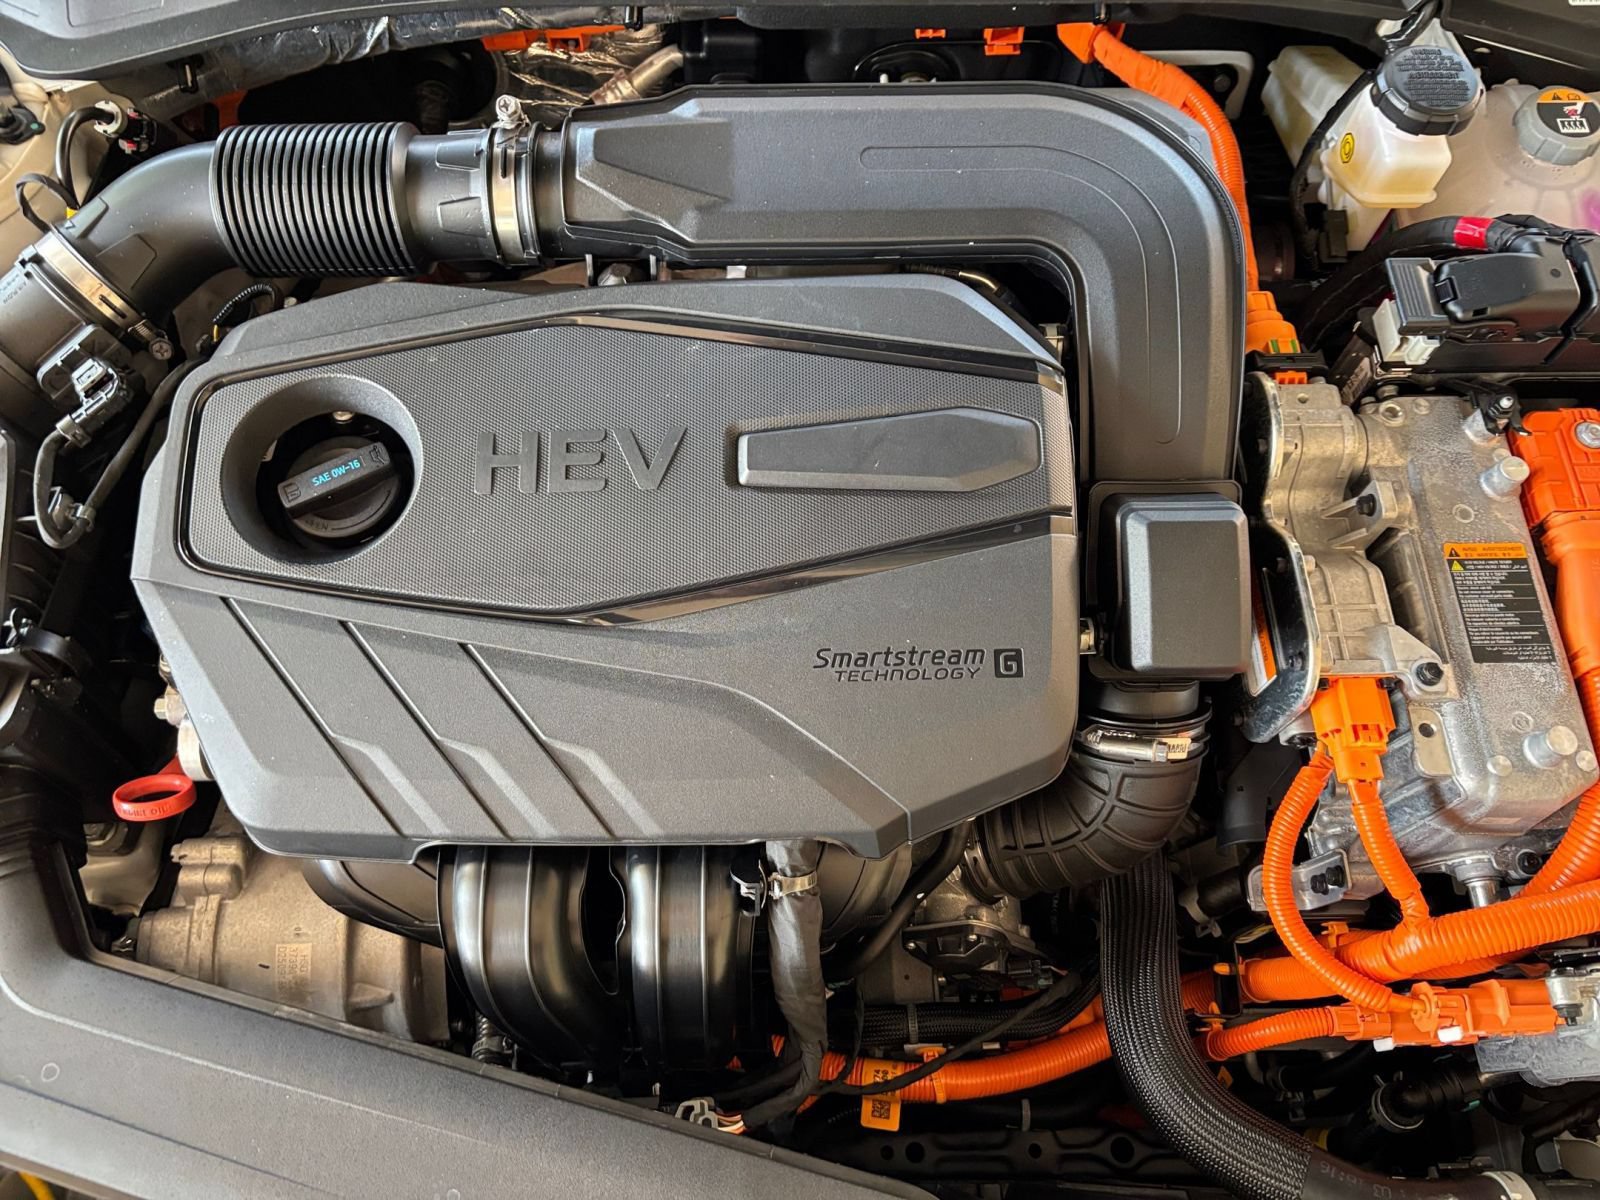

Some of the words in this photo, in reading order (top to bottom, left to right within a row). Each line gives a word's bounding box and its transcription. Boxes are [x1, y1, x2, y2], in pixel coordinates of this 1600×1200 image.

[311, 472, 330, 487] SAE
[331, 459, 361, 478] 0W-16
[474, 425, 687, 495] HEV
[813, 646, 985, 669] Smartstream
[996, 649, 1022, 677] G
[834, 667, 981, 682] TECHNOLOGY
